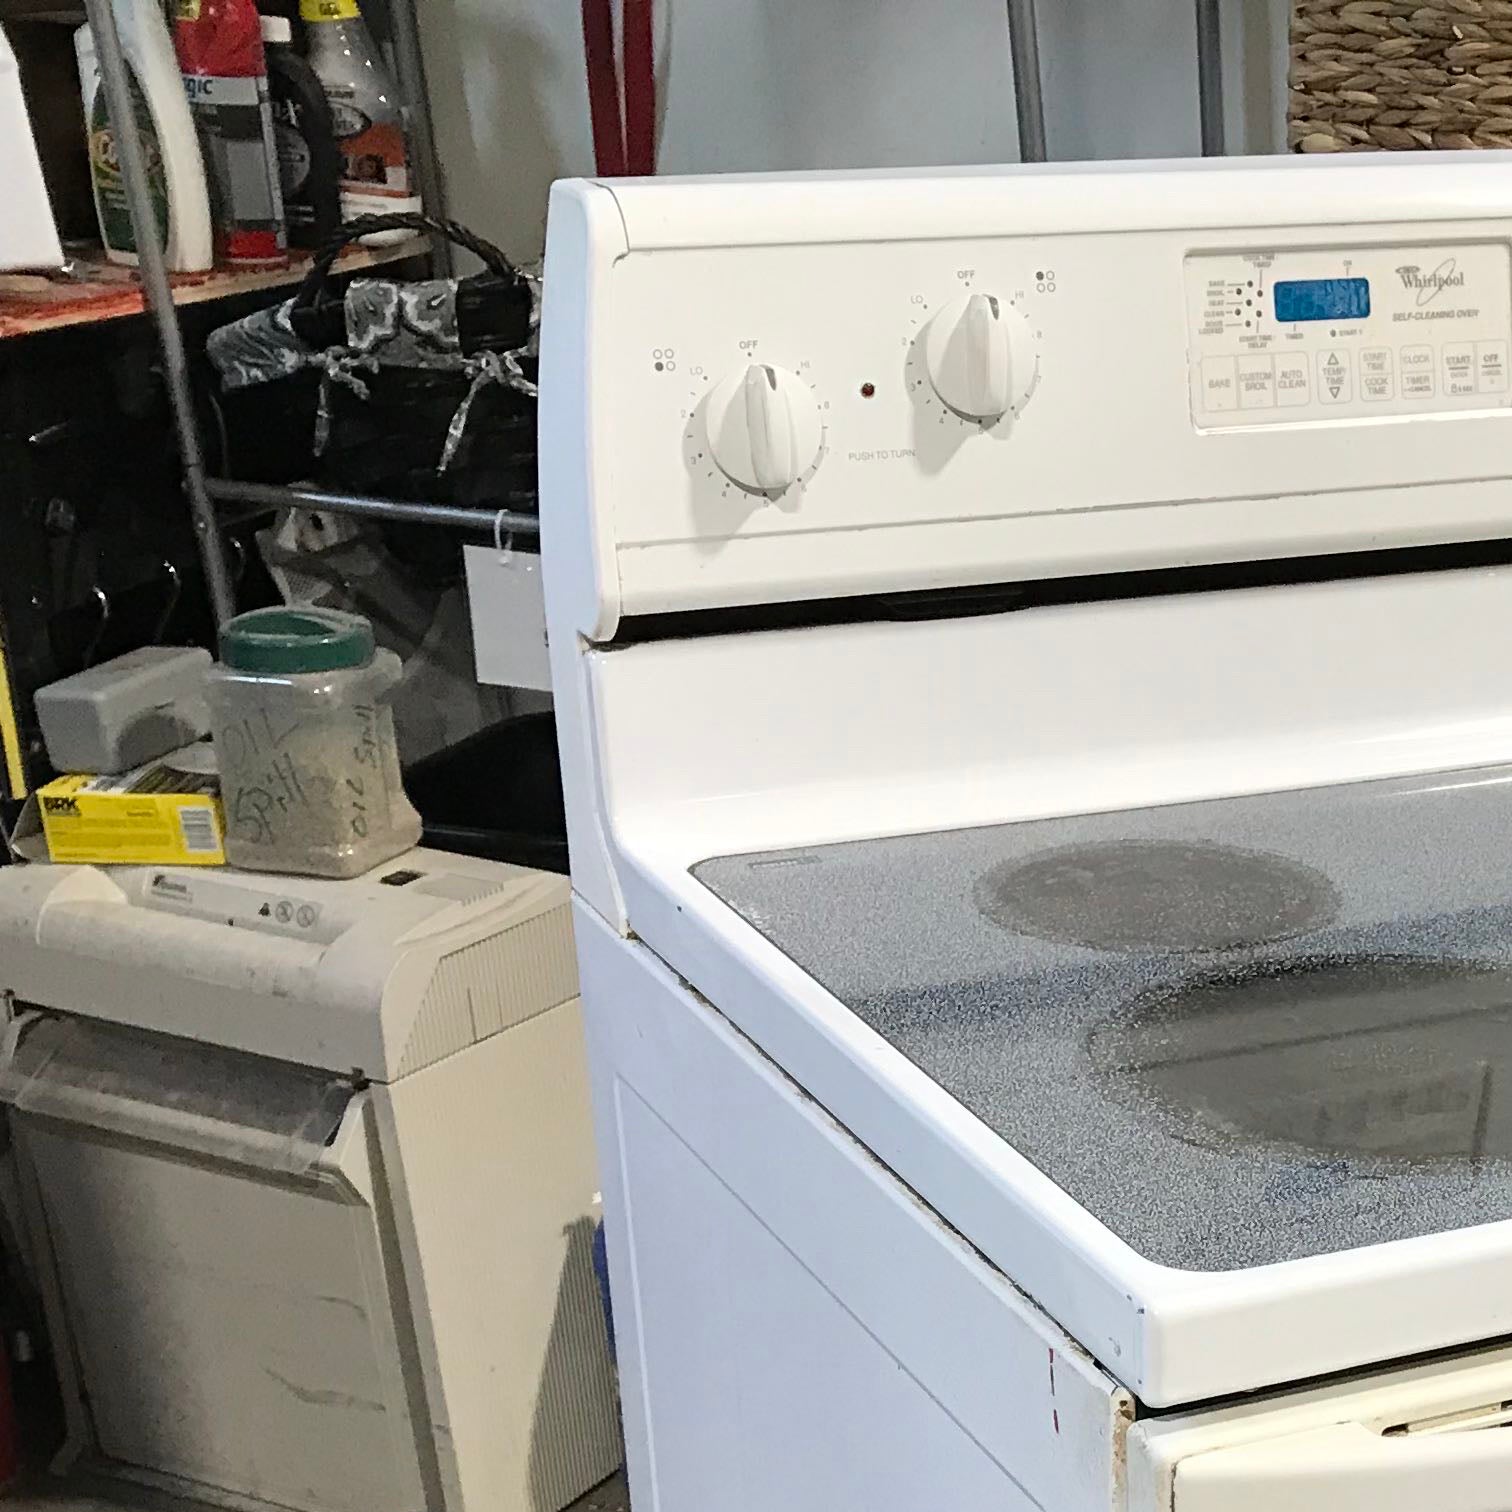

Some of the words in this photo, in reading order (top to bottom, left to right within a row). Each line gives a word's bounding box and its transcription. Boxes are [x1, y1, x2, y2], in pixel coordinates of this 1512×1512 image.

[183, 78, 213, 96] gic
[957, 270, 975, 279] OFF
[1400, 271, 1464, 291] Whirlpool
[1015, 290, 1025, 298] HI
[911, 295, 923, 304] LO
[1392, 310, 1455, 322] SELF-CLEANING
[739, 340, 758, 349] OFF
[1403, 354, 1430, 364] CLOCK
[1483, 353, 1498, 363] OFF
[690, 367, 703, 376] LO
[1280, 370, 1302, 379] AUTO
[1208, 378, 1231, 388] BAKE
[1278, 379, 1306, 388] CLEAN
[1326, 376, 1344, 384] TIME
[1365, 377, 1388, 385] COOK
[1406, 376, 1430, 385] TIMER
[1245, 382, 1267, 391] BROIL
[1368, 386, 1386, 395] TIME
[848, 452, 873, 461] PUSH
[876, 450, 889, 459] TO
[890, 448, 916, 458] TURN
[223, 708, 302, 776] OIL
[346, 776, 368, 838] OIL
